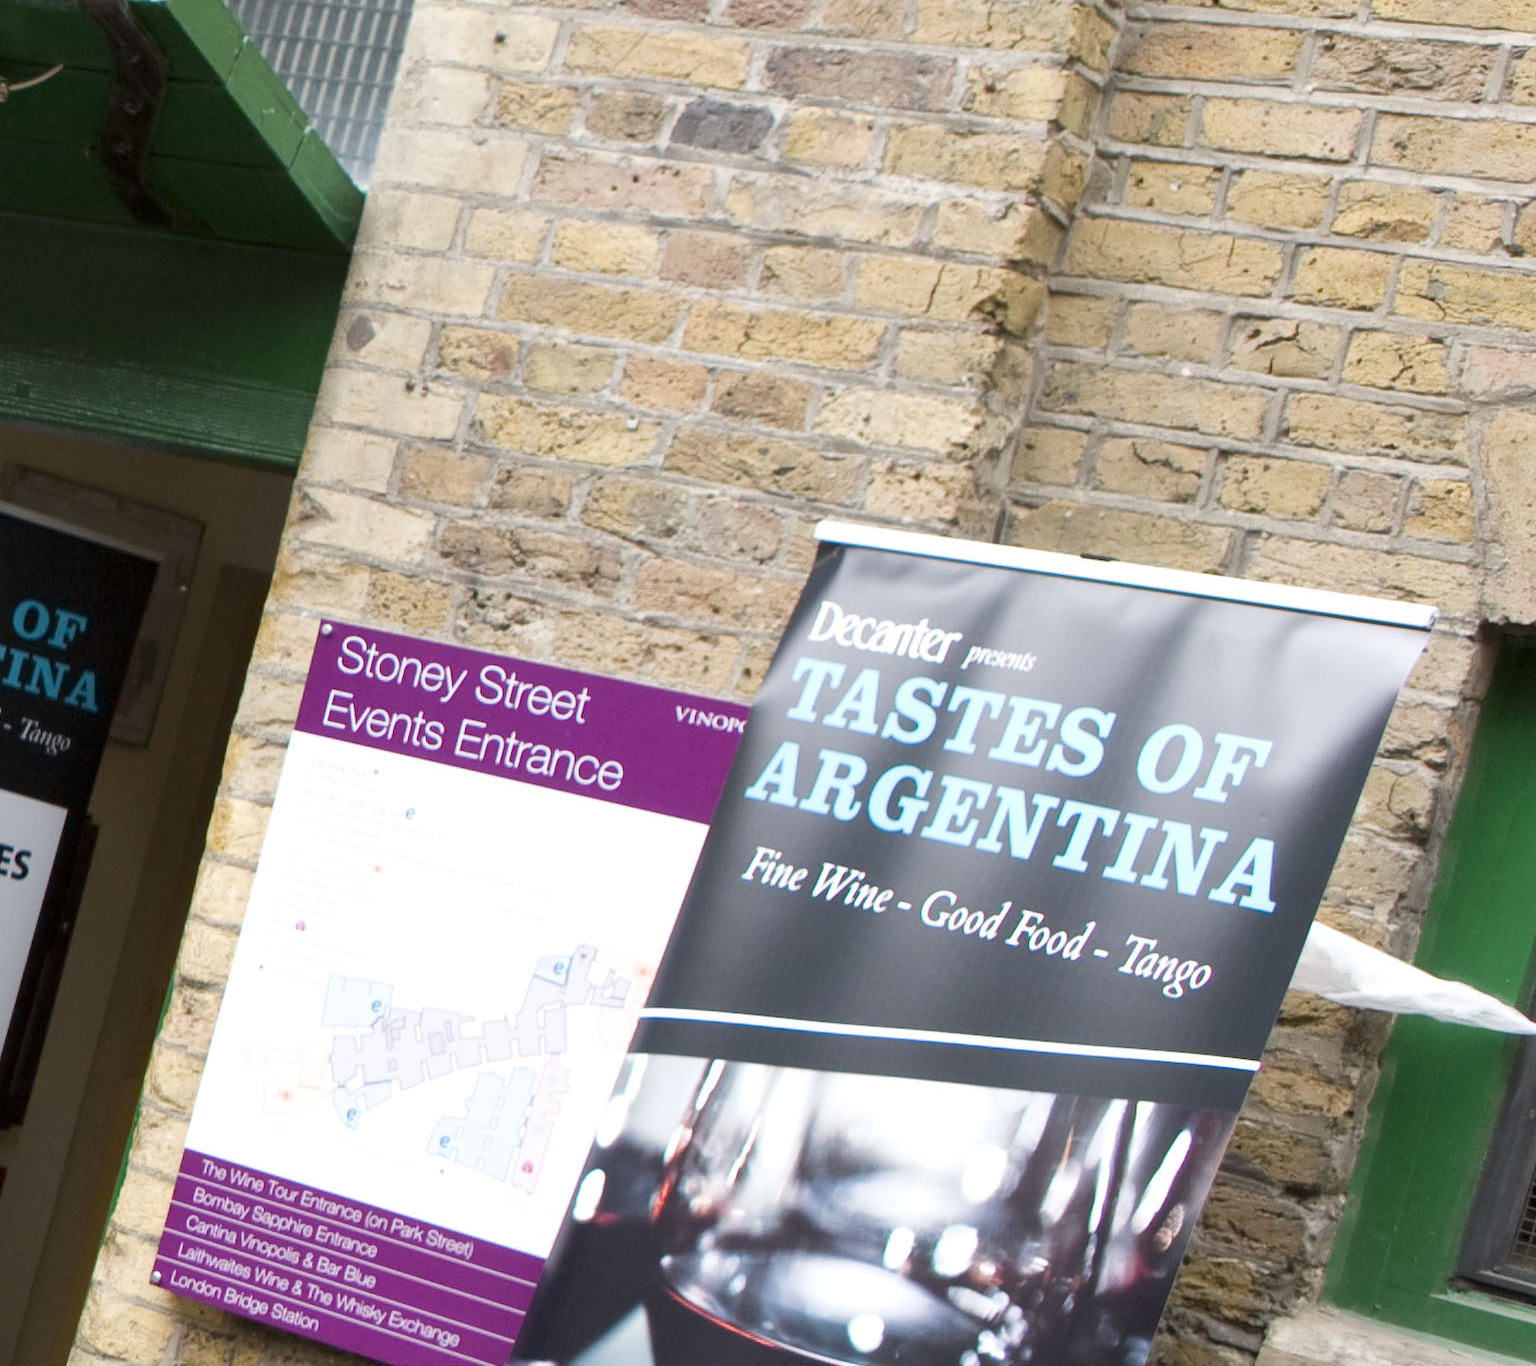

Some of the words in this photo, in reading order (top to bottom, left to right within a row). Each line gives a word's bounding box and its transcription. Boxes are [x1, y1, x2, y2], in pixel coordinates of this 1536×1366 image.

[12, 599, 88, 649] OF
[807, 600, 963, 665] Decanter
[961, 644, 1037, 673] presents
[337, 635, 468, 705] Stoney
[474, 664, 591, 725] Street
[19, 715, 72, 756] Tango
[322, 689, 445, 752] Events
[454, 719, 625, 792] Entrance
[785, 656, 1117, 779] TASTES
[1134, 722, 1274, 805] OF
[743, 740, 1278, 914] ARGENTINA
[740, 845, 809, 893] Fine
[811, 861, 895, 914] Wine
[919, 889, 1013, 941] Good
[1005, 908, 1097, 962] Food
[1117, 933, 1213, 1000] Tango
[185, 1214, 237, 1245] Cantina
[240, 1230, 300, 1266] Vinopolis
[302, 1251, 314, 1270] &
[316, 1255, 342, 1278] Bar
[343, 1265, 377, 1290] Blue
[192, 1186, 251, 1220] Bombay
[251, 1203, 314, 1239] Sapphire
[314, 1224, 379, 1259] Entrance
[201, 1158, 227, 1182] The
[229, 1170, 265, 1193] Wine
[268, 1179, 300, 1203] Tour
[300, 1190, 362, 1223] Entrance
[363, 1209, 389, 1233] (on
[389, 1217, 423, 1242] Park
[425, 1229, 474, 1260] Street)
[169, 1269, 223, 1301] London
[223, 1285, 269, 1318] Bridge
[270, 1302, 320, 1333] Station
[177, 1241, 251, 1280] Laithwaites
[254, 1266, 290, 1293] Wine
[291, 1277, 303, 1296] &
[306, 1283, 333, 1307] The
[336, 1292, 388, 1325] Whisky
[388, 1309, 461, 1349] Exchange
